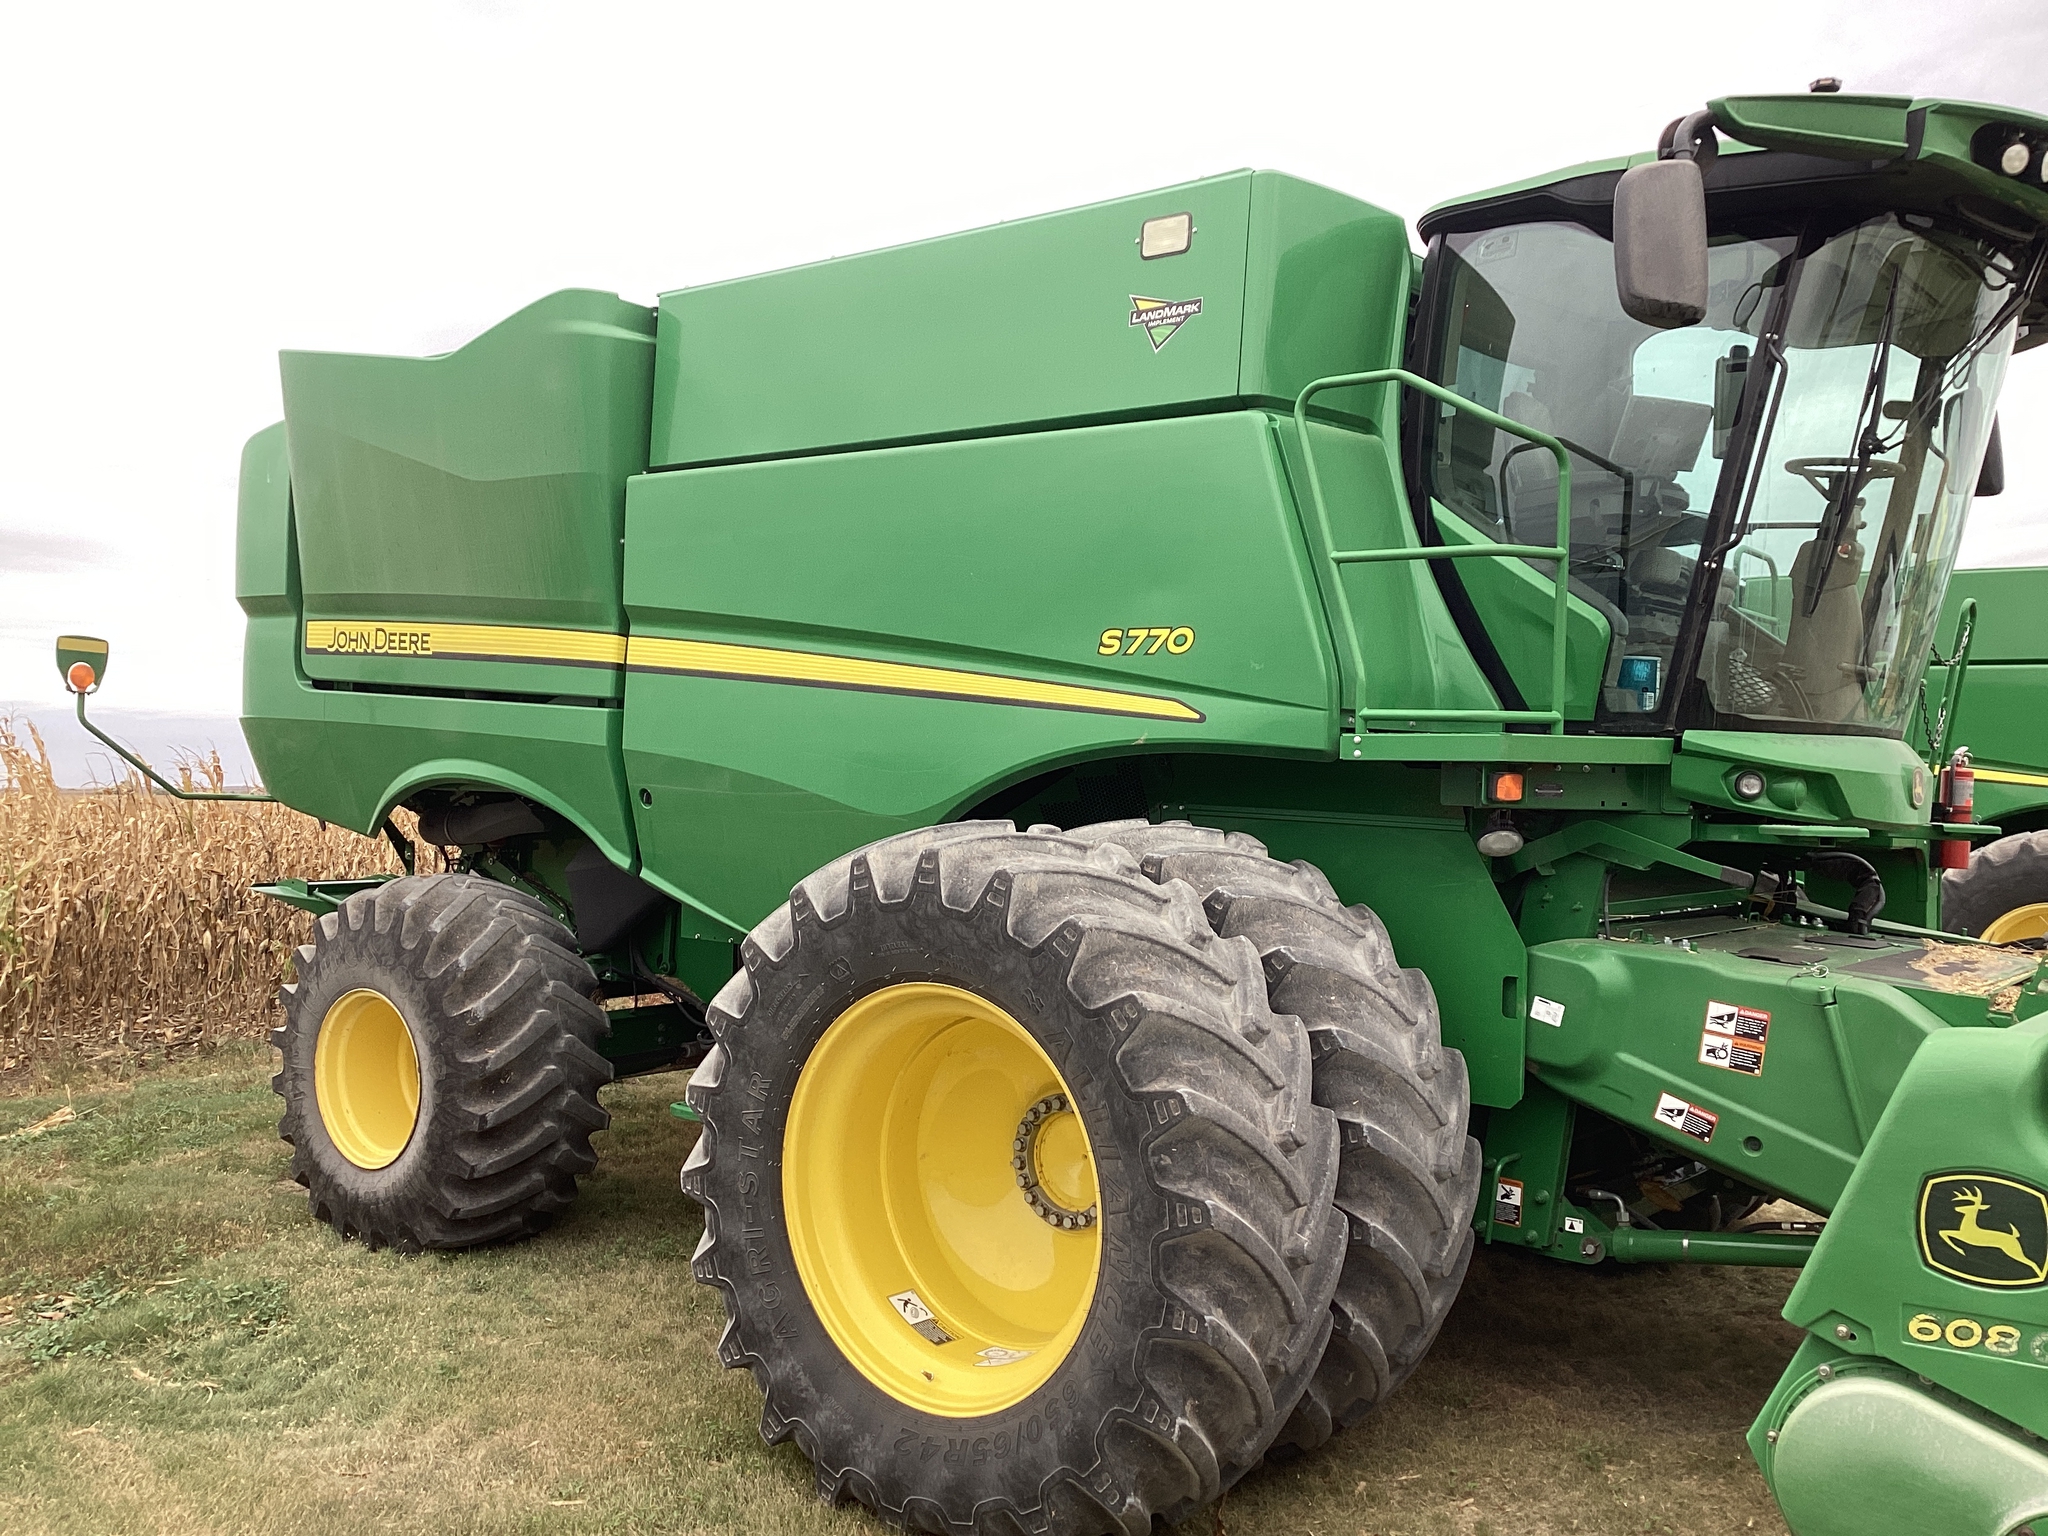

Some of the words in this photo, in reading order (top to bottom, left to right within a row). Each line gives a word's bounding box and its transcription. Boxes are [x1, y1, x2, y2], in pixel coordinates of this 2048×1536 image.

[1131, 302, 1200, 323] LANDMARK
[326, 626, 371, 650] JOHN
[374, 627, 431, 652] DEERE
[1097, 626, 1195, 656] S770
[1744, 1009, 1768, 1020] DANGER
[738, 1071, 799, 1341] AGRI-STAR
[893, 1379, 1080, 1467] 650/65R42
